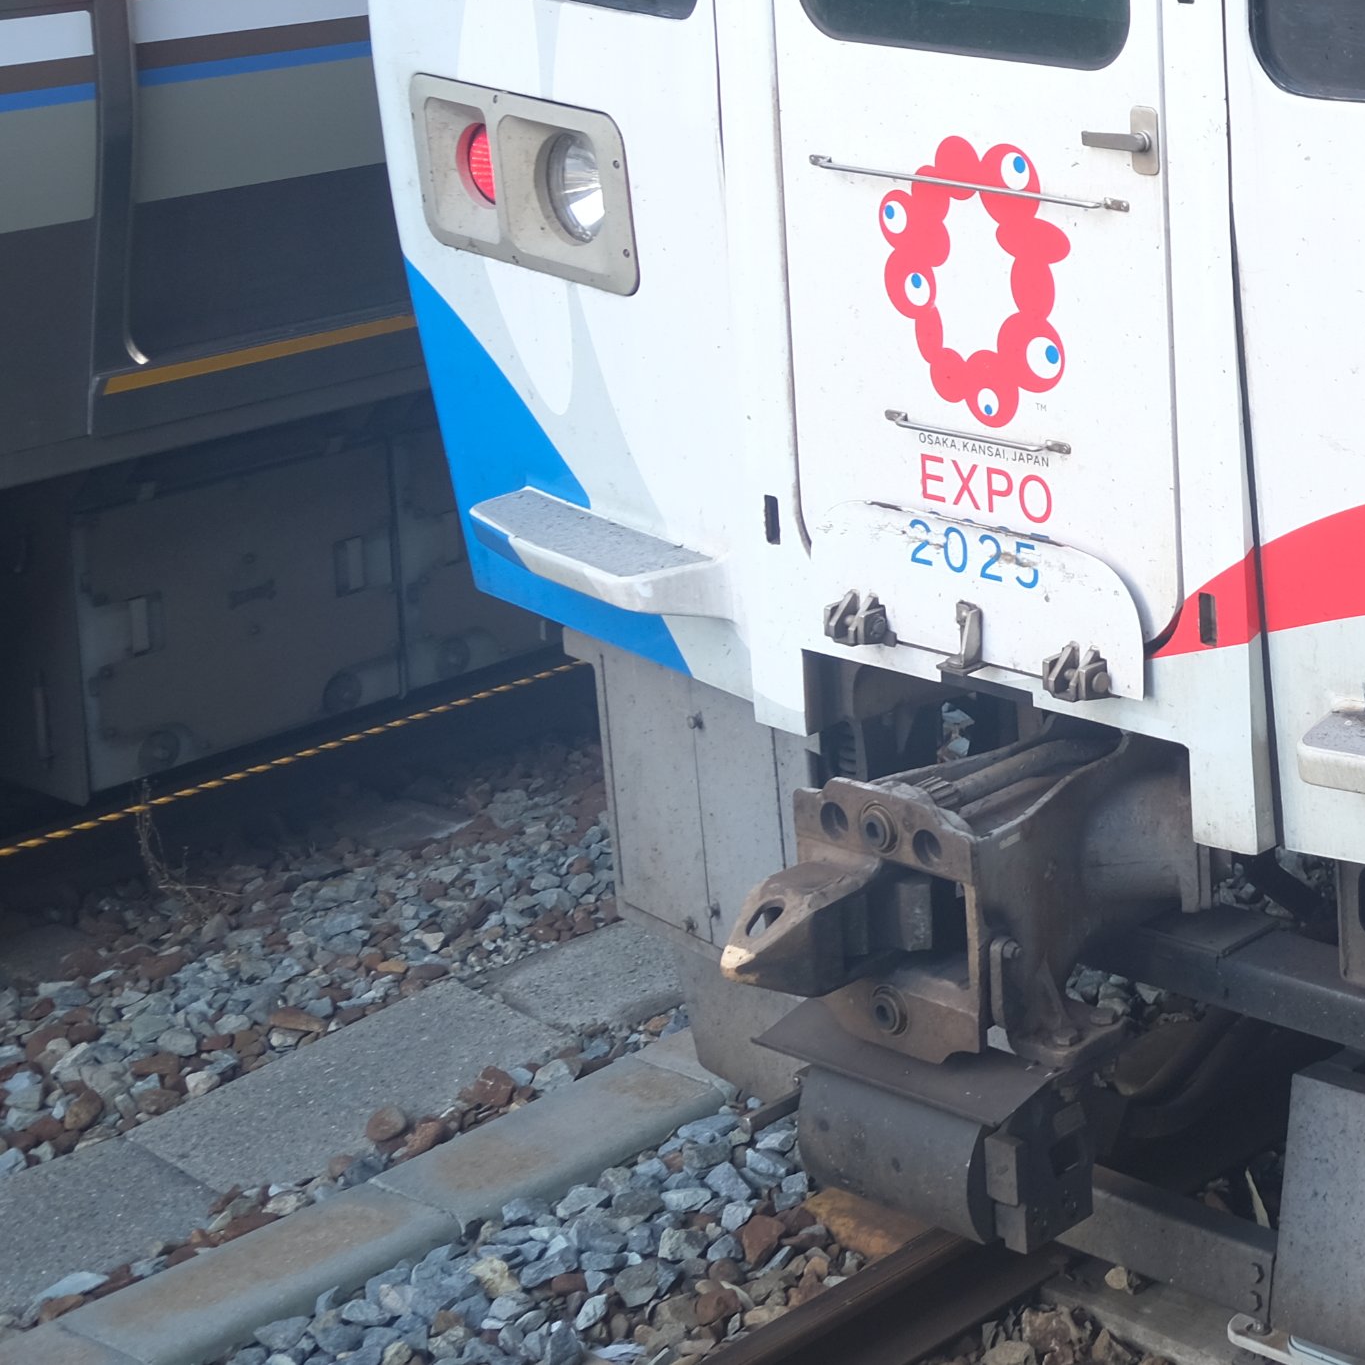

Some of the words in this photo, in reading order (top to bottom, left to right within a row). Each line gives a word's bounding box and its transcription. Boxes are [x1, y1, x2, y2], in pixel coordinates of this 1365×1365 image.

[918, 432, 961, 452] OSAKA,
[962, 441, 1009, 463] KANSAI,
[1011, 451, 1050, 468] JAPAN
[919, 453, 1053, 524] EXPO
[908, 517, 1040, 590] 2025
